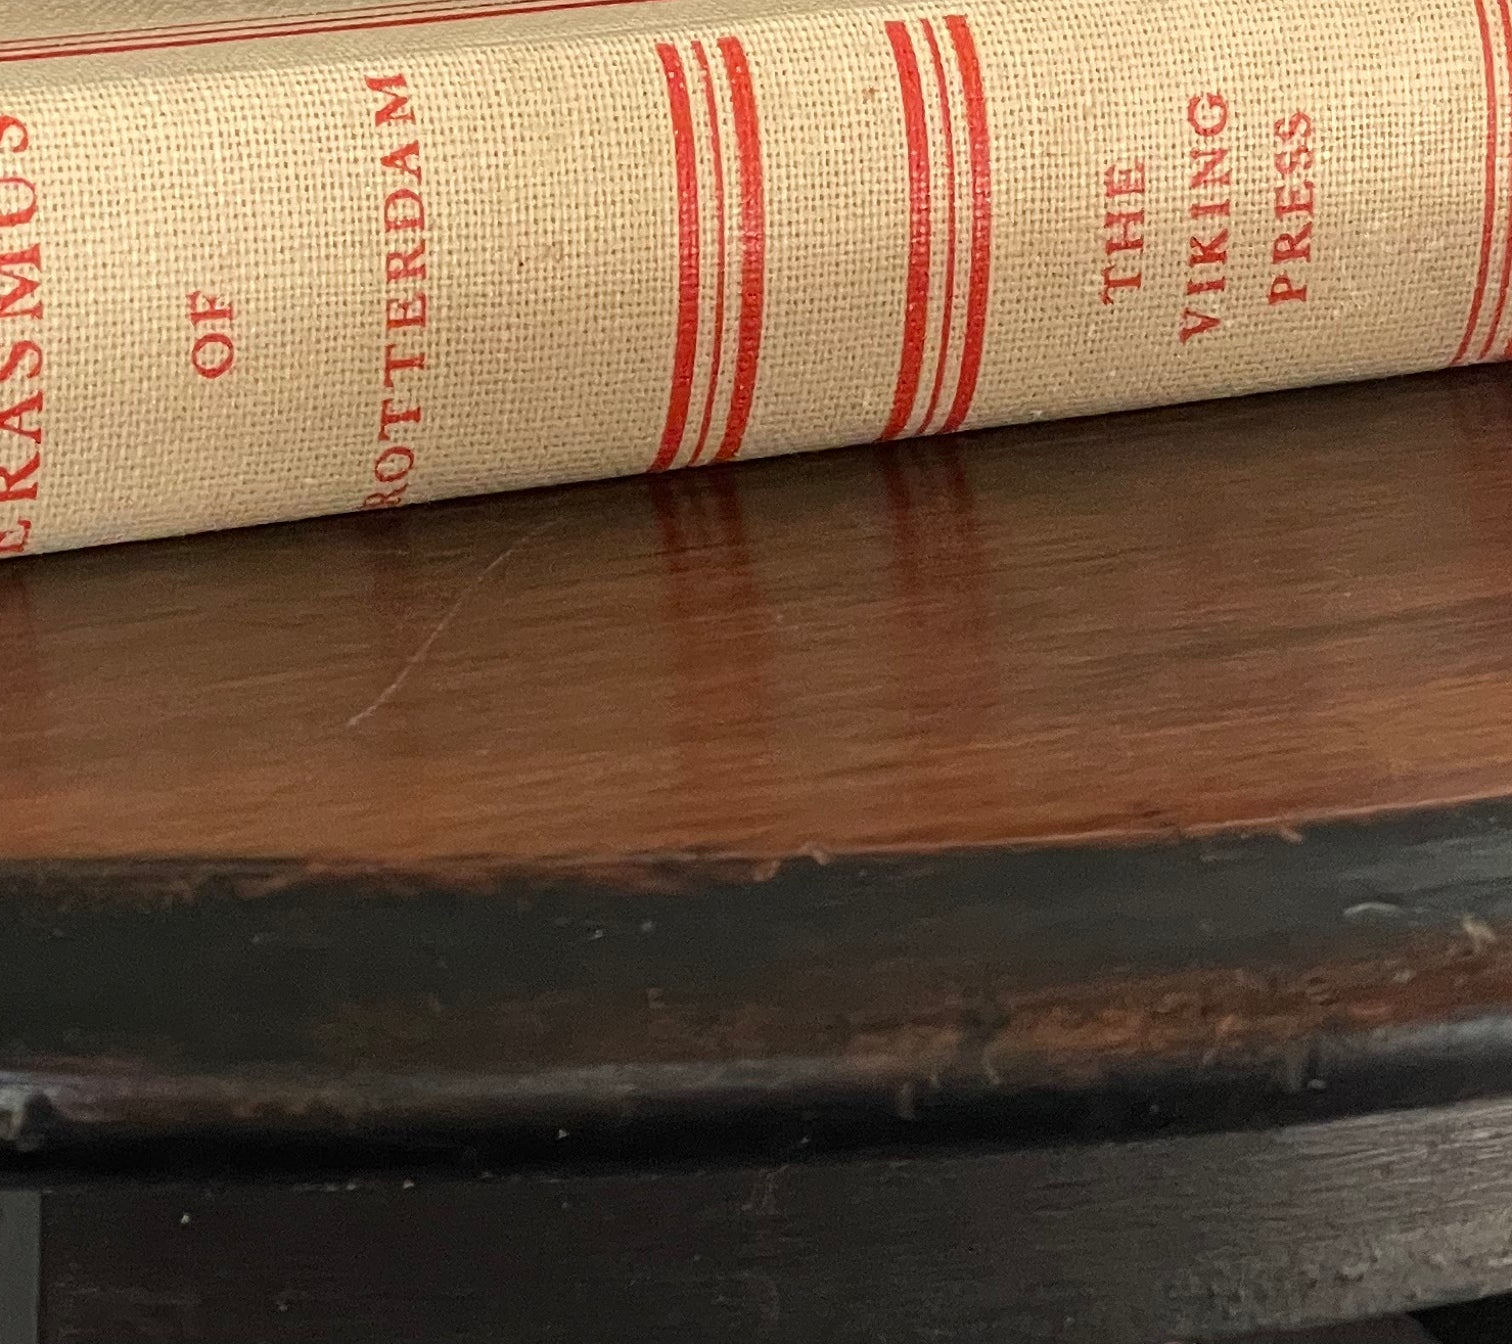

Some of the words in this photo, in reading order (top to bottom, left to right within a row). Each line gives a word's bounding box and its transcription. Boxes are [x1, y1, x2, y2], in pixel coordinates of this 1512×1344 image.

[362, 73, 428, 510] ROTTERDAM
[1101, 161, 1145, 306] THE
[1179, 91, 1232, 343] VIKING
[1267, 110, 1316, 306] PRESS
[188, 290, 235, 380] OF
